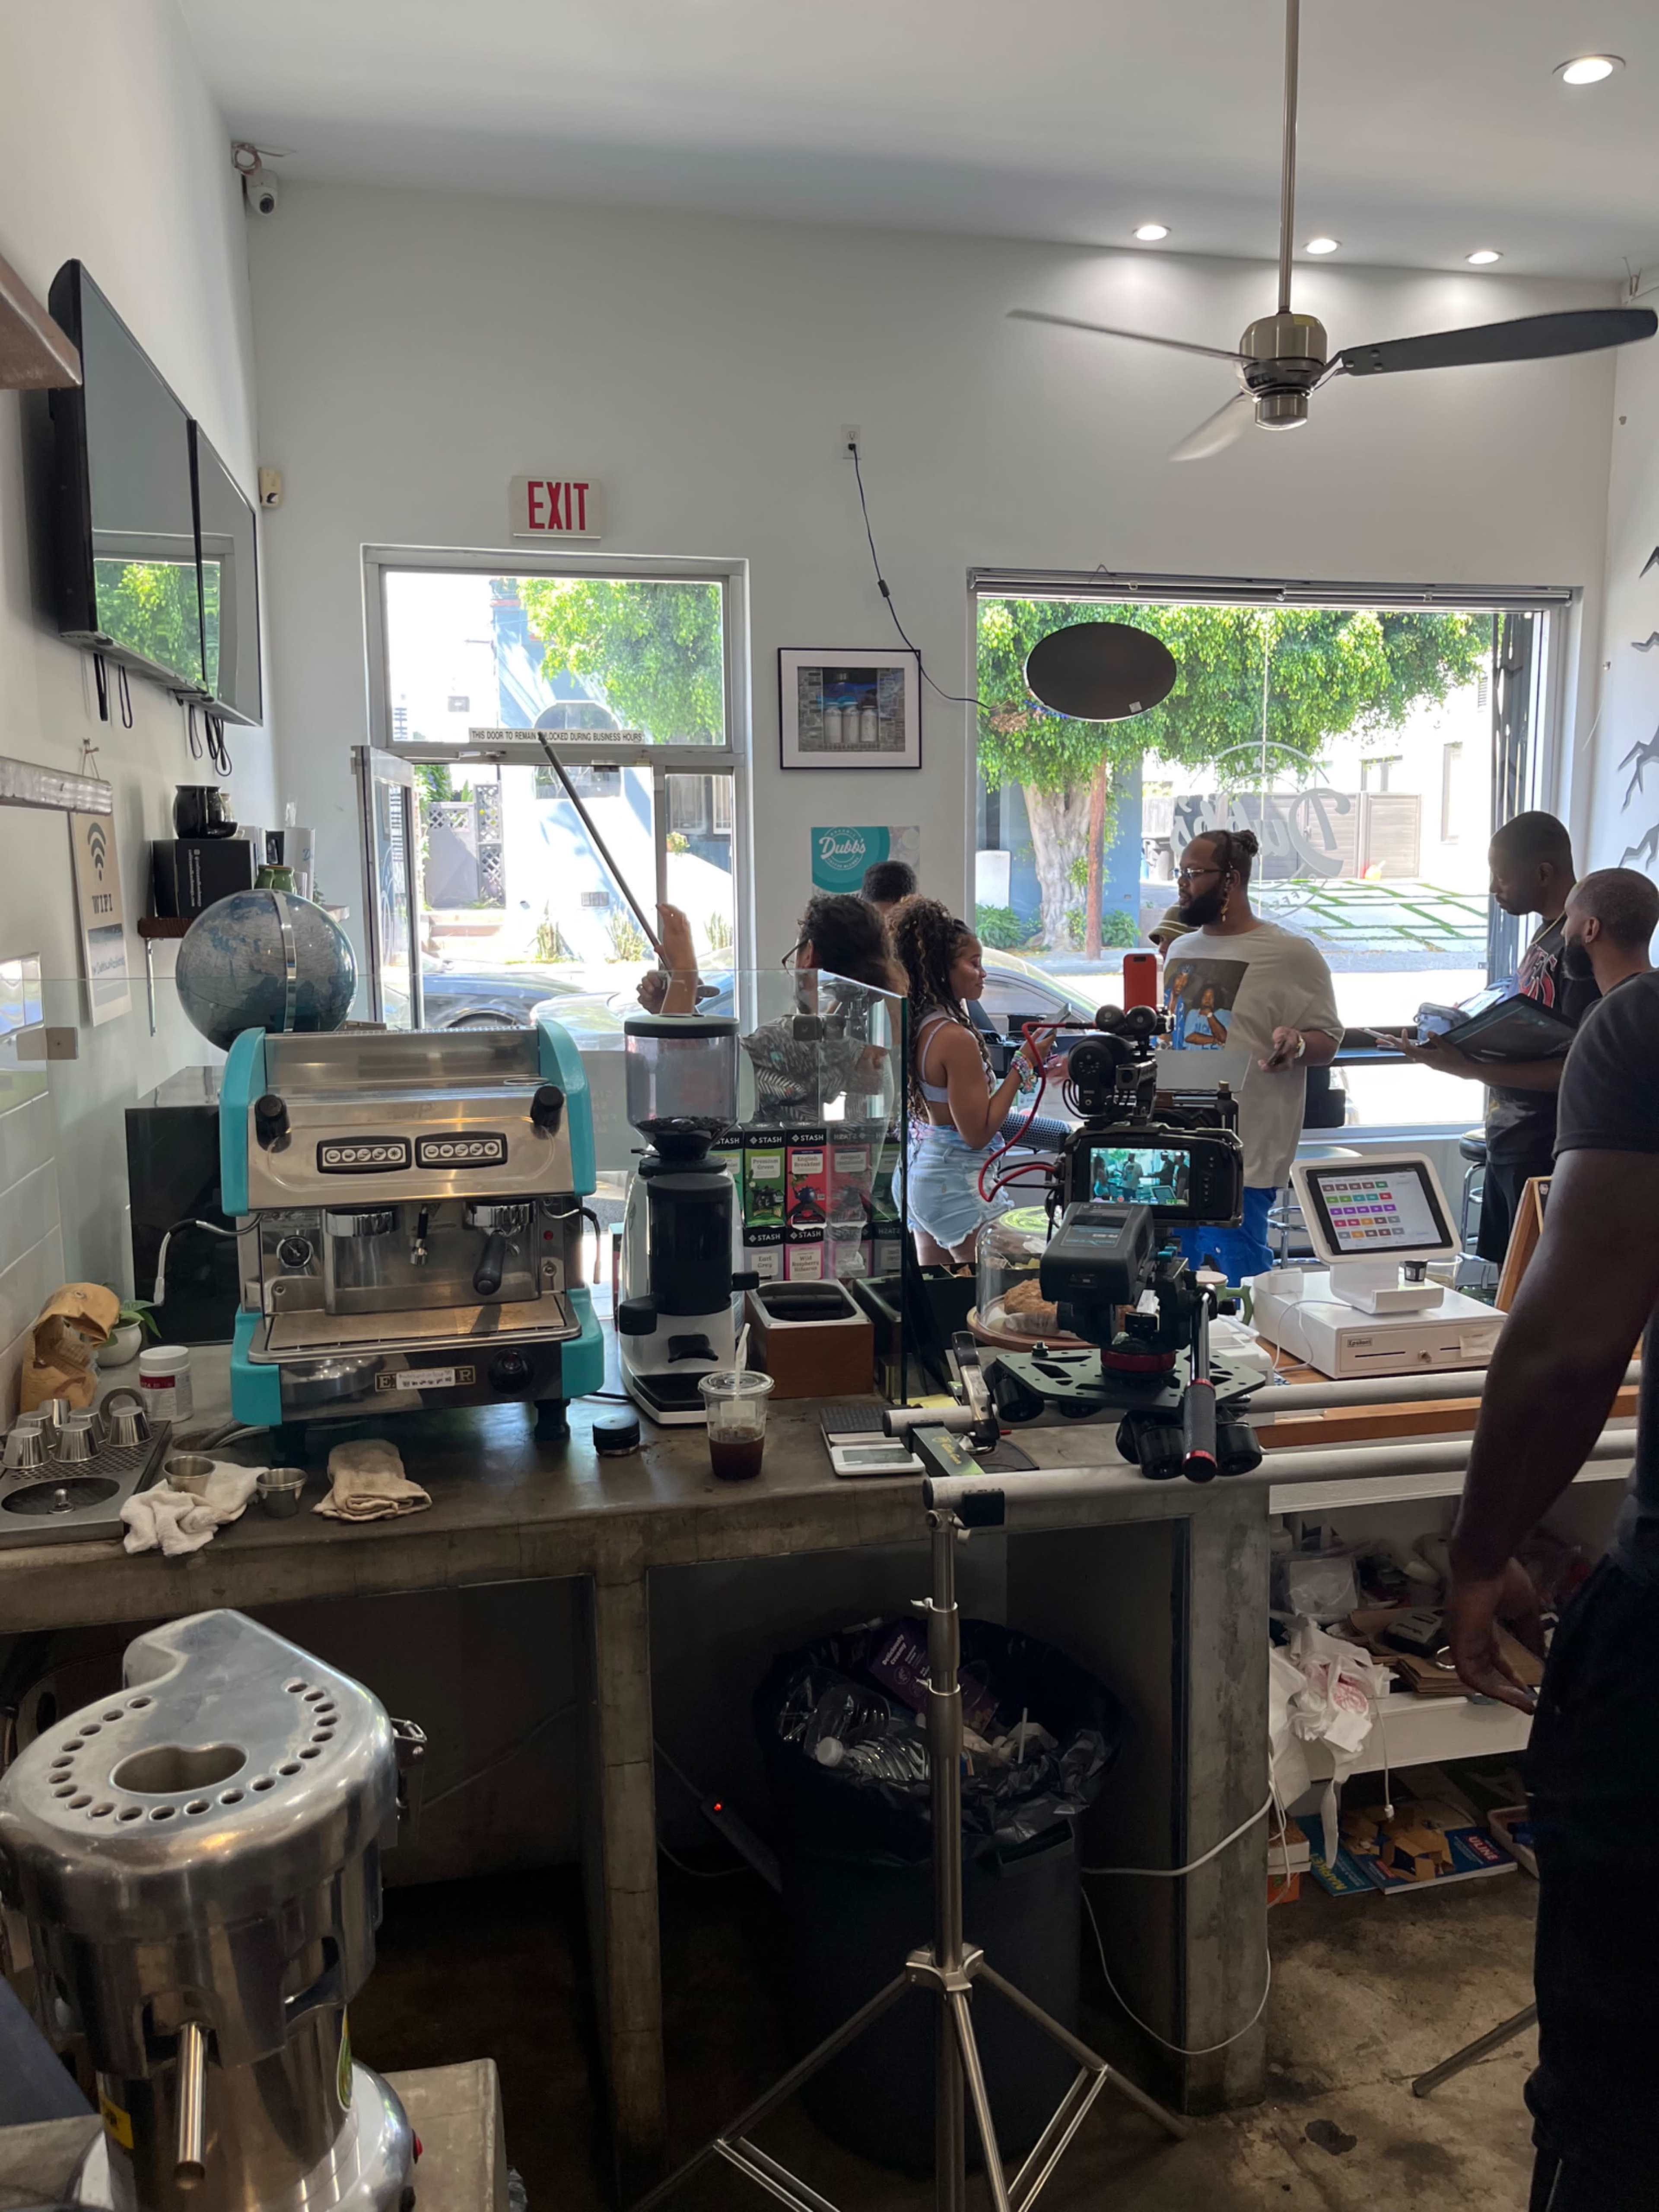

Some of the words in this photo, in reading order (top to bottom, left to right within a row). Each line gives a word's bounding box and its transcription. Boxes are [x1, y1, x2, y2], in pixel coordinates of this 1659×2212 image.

[528, 481, 589, 531] EXIT
[472, 731, 484, 739] THIS
[487, 731, 503, 740] DOOR
[505, 731, 512, 740] TO
[515, 731, 536, 740] REMAIN
[570, 732, 591, 741] DURING
[593, 732, 620, 741] BUSINESS
[622, 733, 642, 741] HOURS
[819, 836, 866, 860] Dubb's
[92, 893, 113, 914] WIFI
[757, 1233, 781, 1242] STASH
[1468, 1835, 1500, 1861] ULINE
